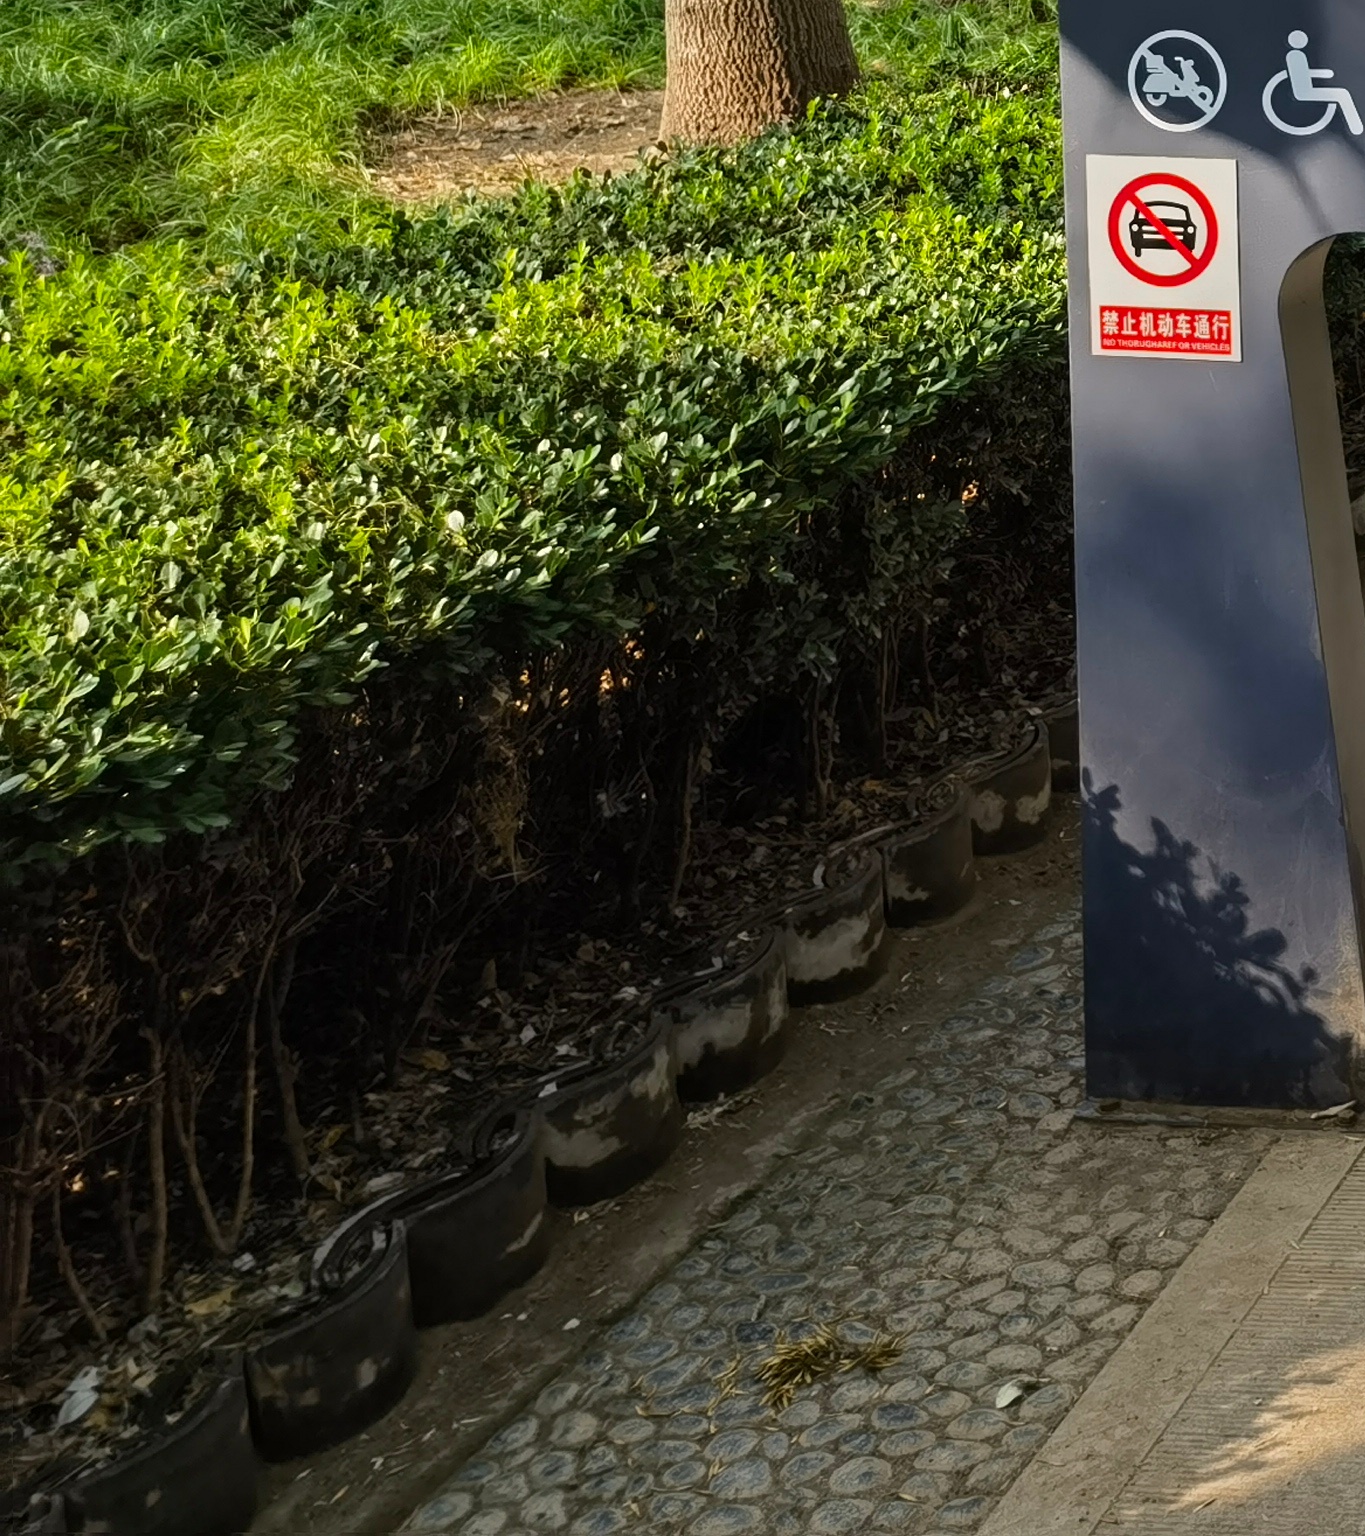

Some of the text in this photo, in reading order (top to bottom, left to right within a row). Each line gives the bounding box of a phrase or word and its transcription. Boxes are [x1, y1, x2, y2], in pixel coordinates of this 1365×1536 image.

[1102, 310, 1230, 341] 禁止机动车通行
[1103, 338, 1116, 347] NO
[1191, 343, 1230, 352] VEHICLES
